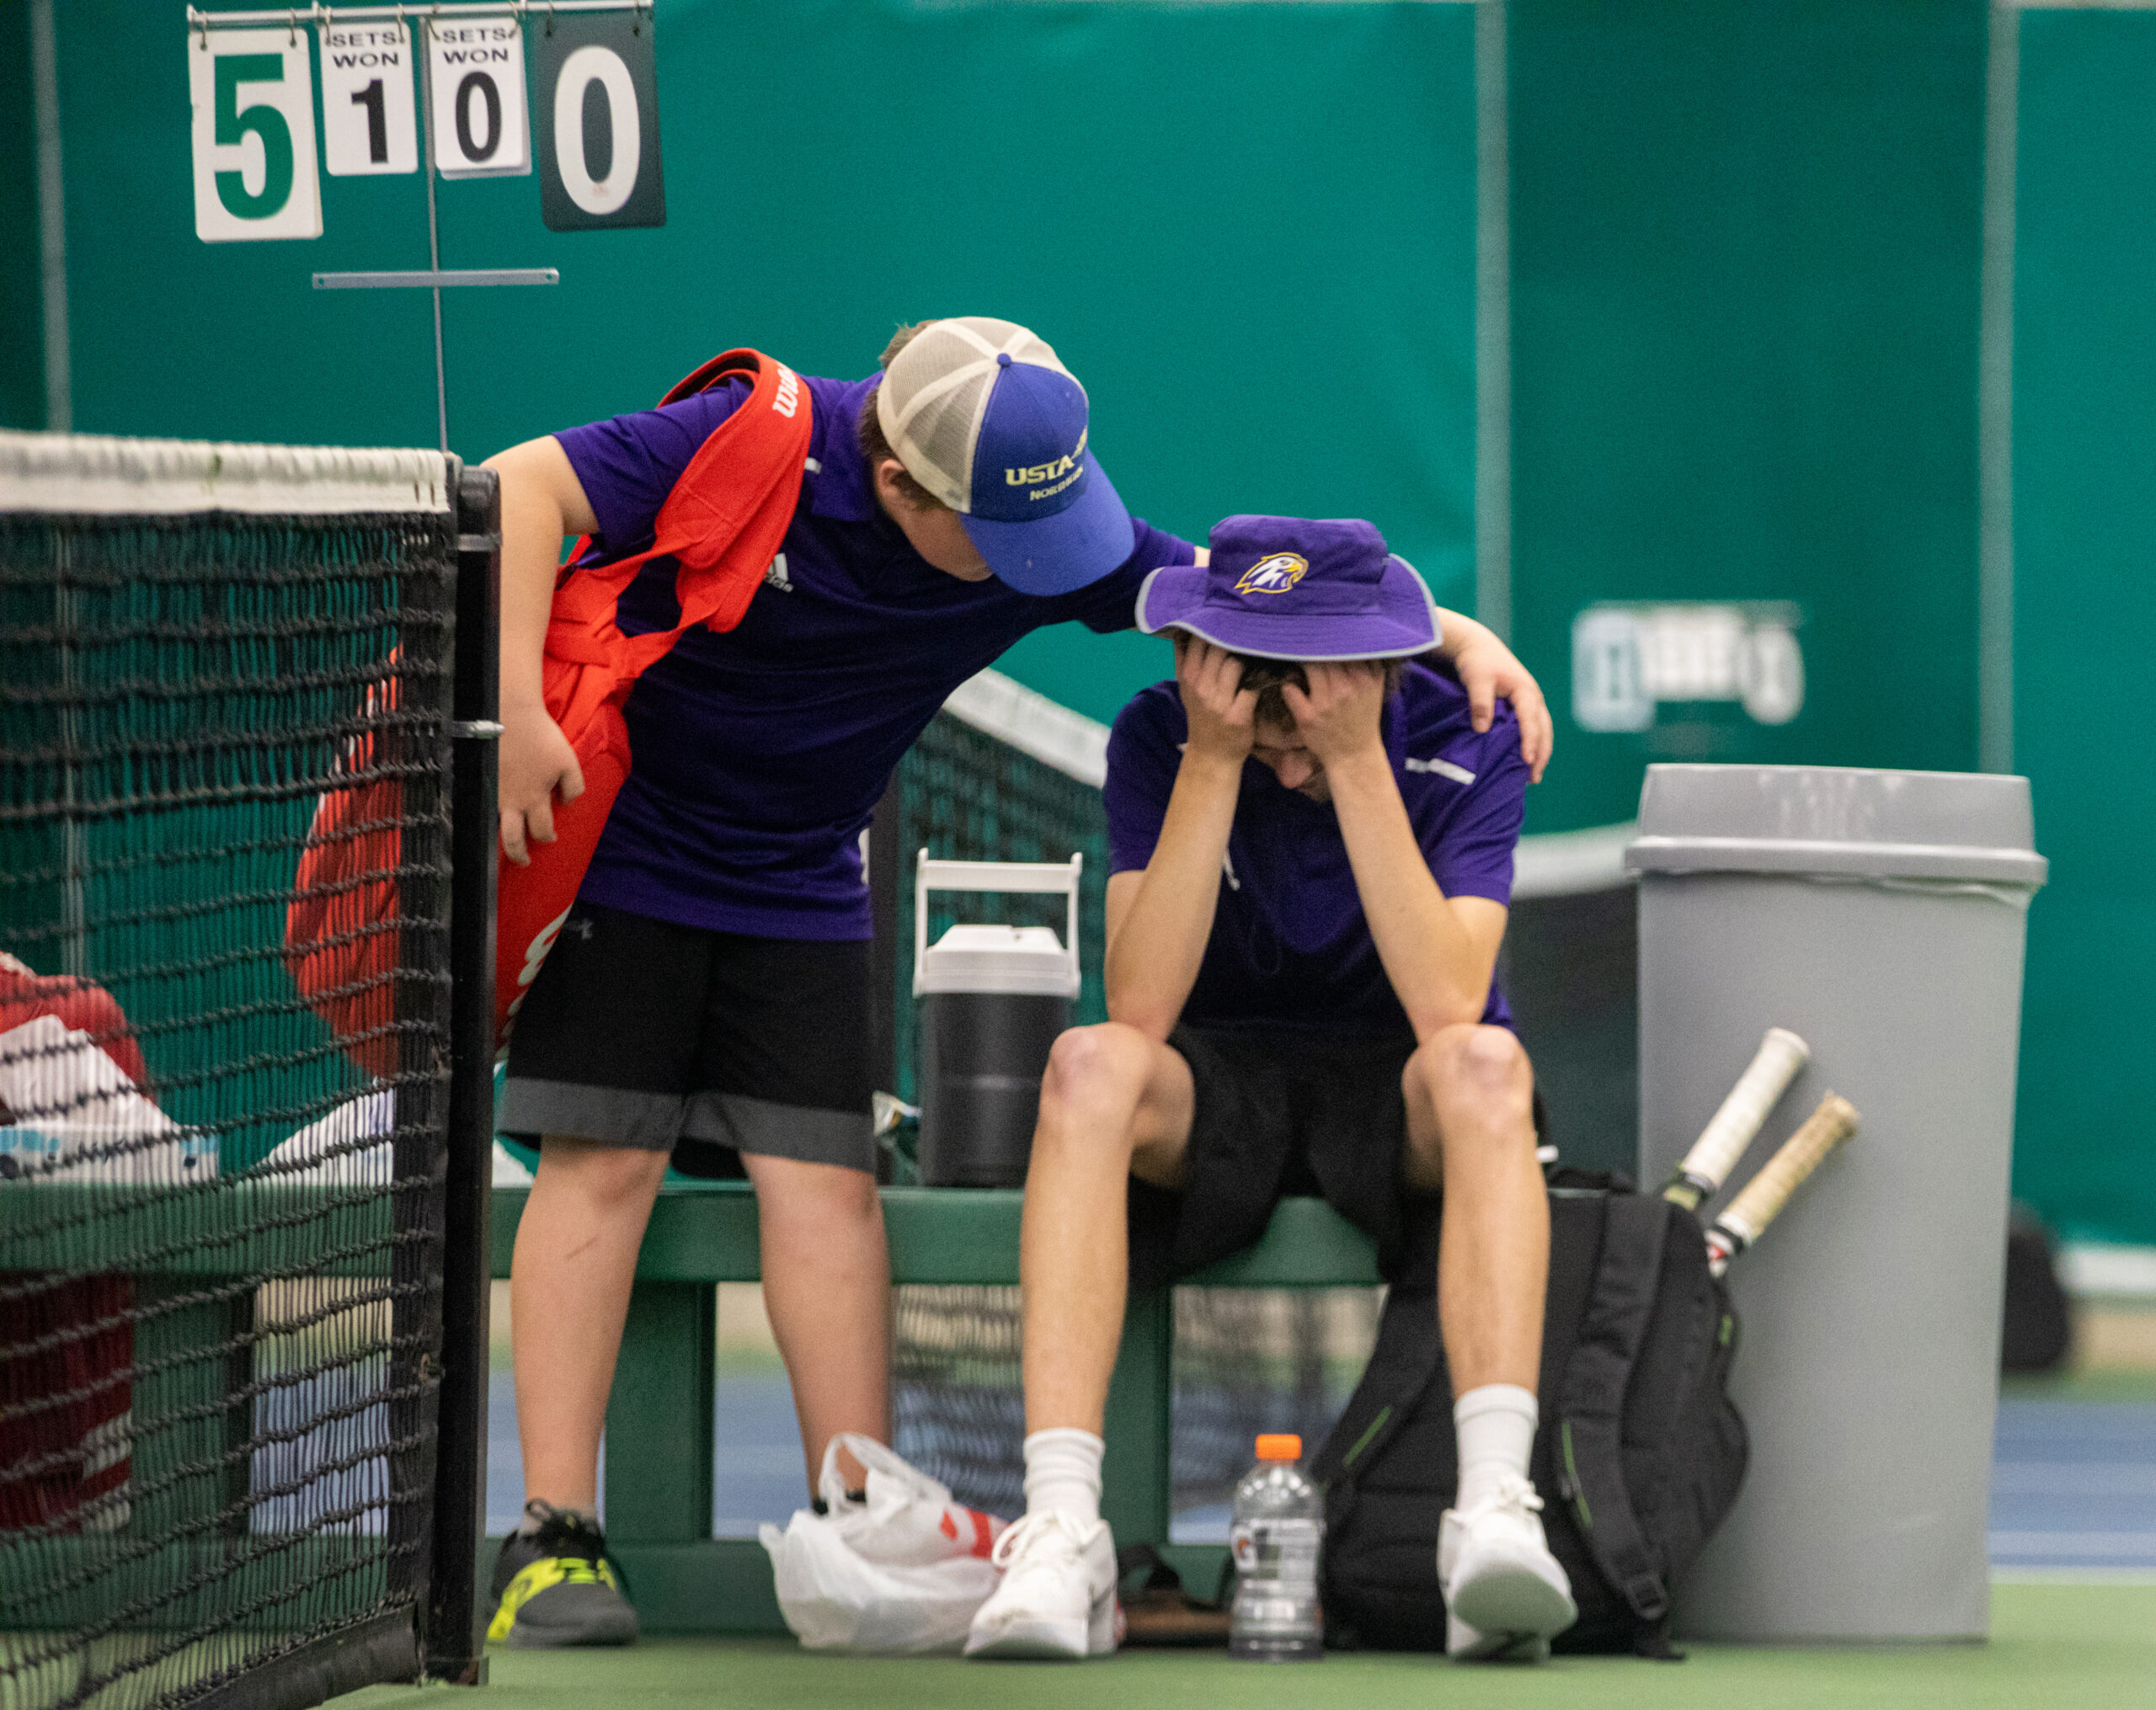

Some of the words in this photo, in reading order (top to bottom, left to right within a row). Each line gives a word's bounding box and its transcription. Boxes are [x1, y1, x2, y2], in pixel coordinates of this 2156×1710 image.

[333, 31, 396, 47] SETS
[443, 28, 510, 44] SETS
[333, 52, 399, 68] WON
[443, 48, 509, 64] WON
[351, 78, 388, 163] 1
[456, 71, 501, 162] 0
[554, 45, 640, 214] 0
[214, 53, 294, 220] 5
[1005, 455, 1075, 486] USTA
